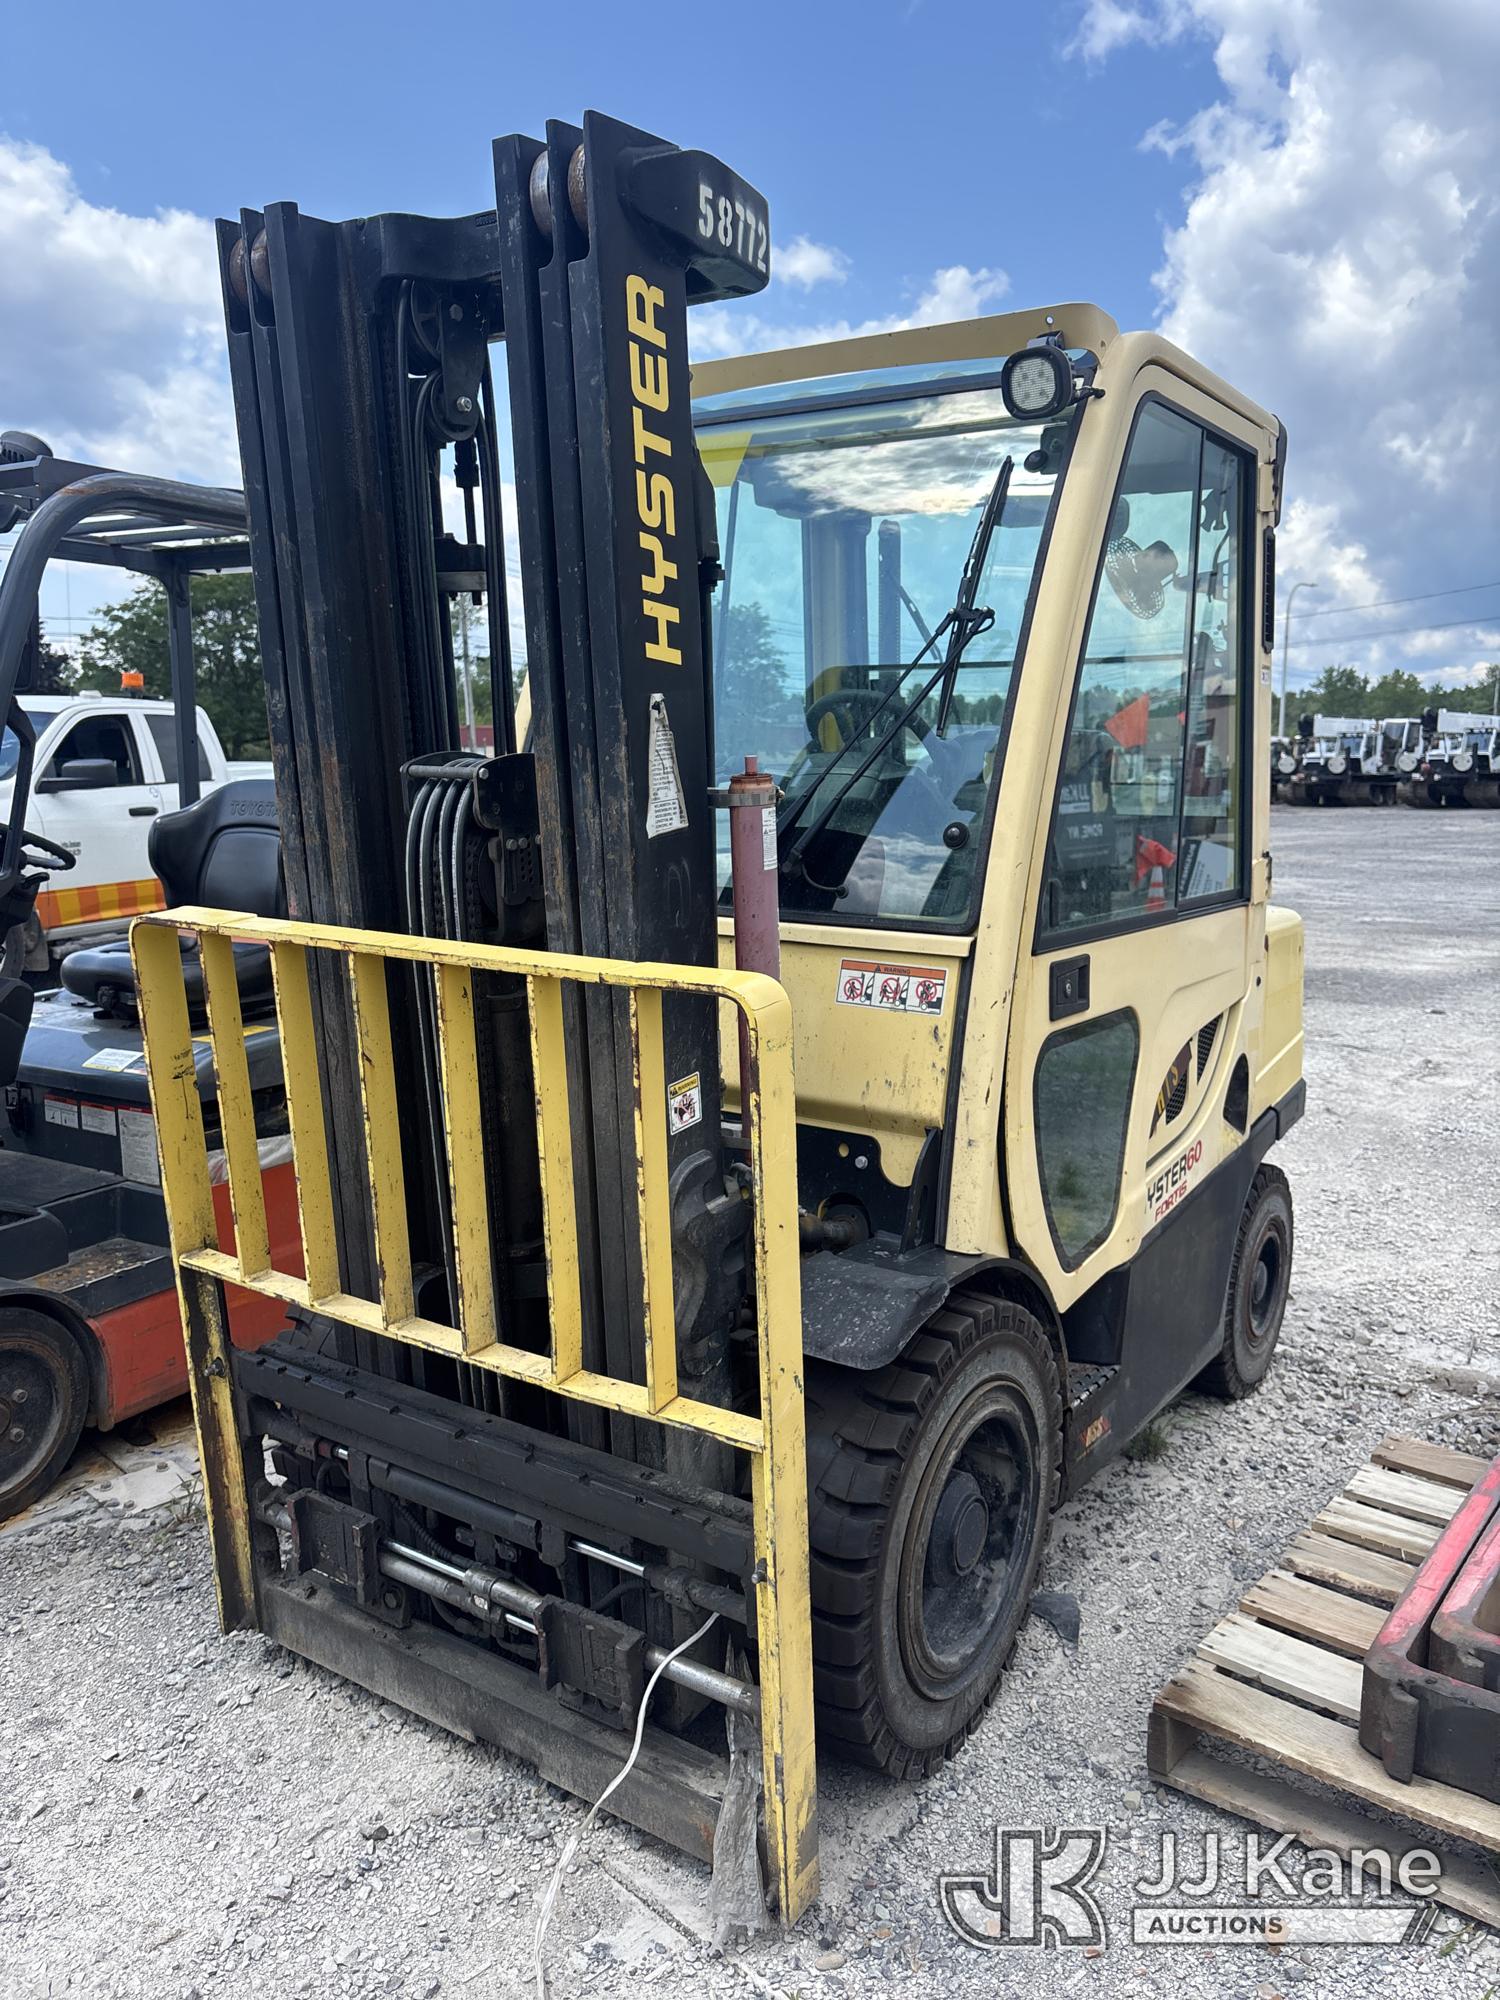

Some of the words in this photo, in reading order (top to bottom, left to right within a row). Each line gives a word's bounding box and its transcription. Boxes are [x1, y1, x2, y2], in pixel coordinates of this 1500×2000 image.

[699, 184, 767, 273] 58772
[626, 274, 682, 666] HYSTER
[884, 966, 911, 976] WARNING
